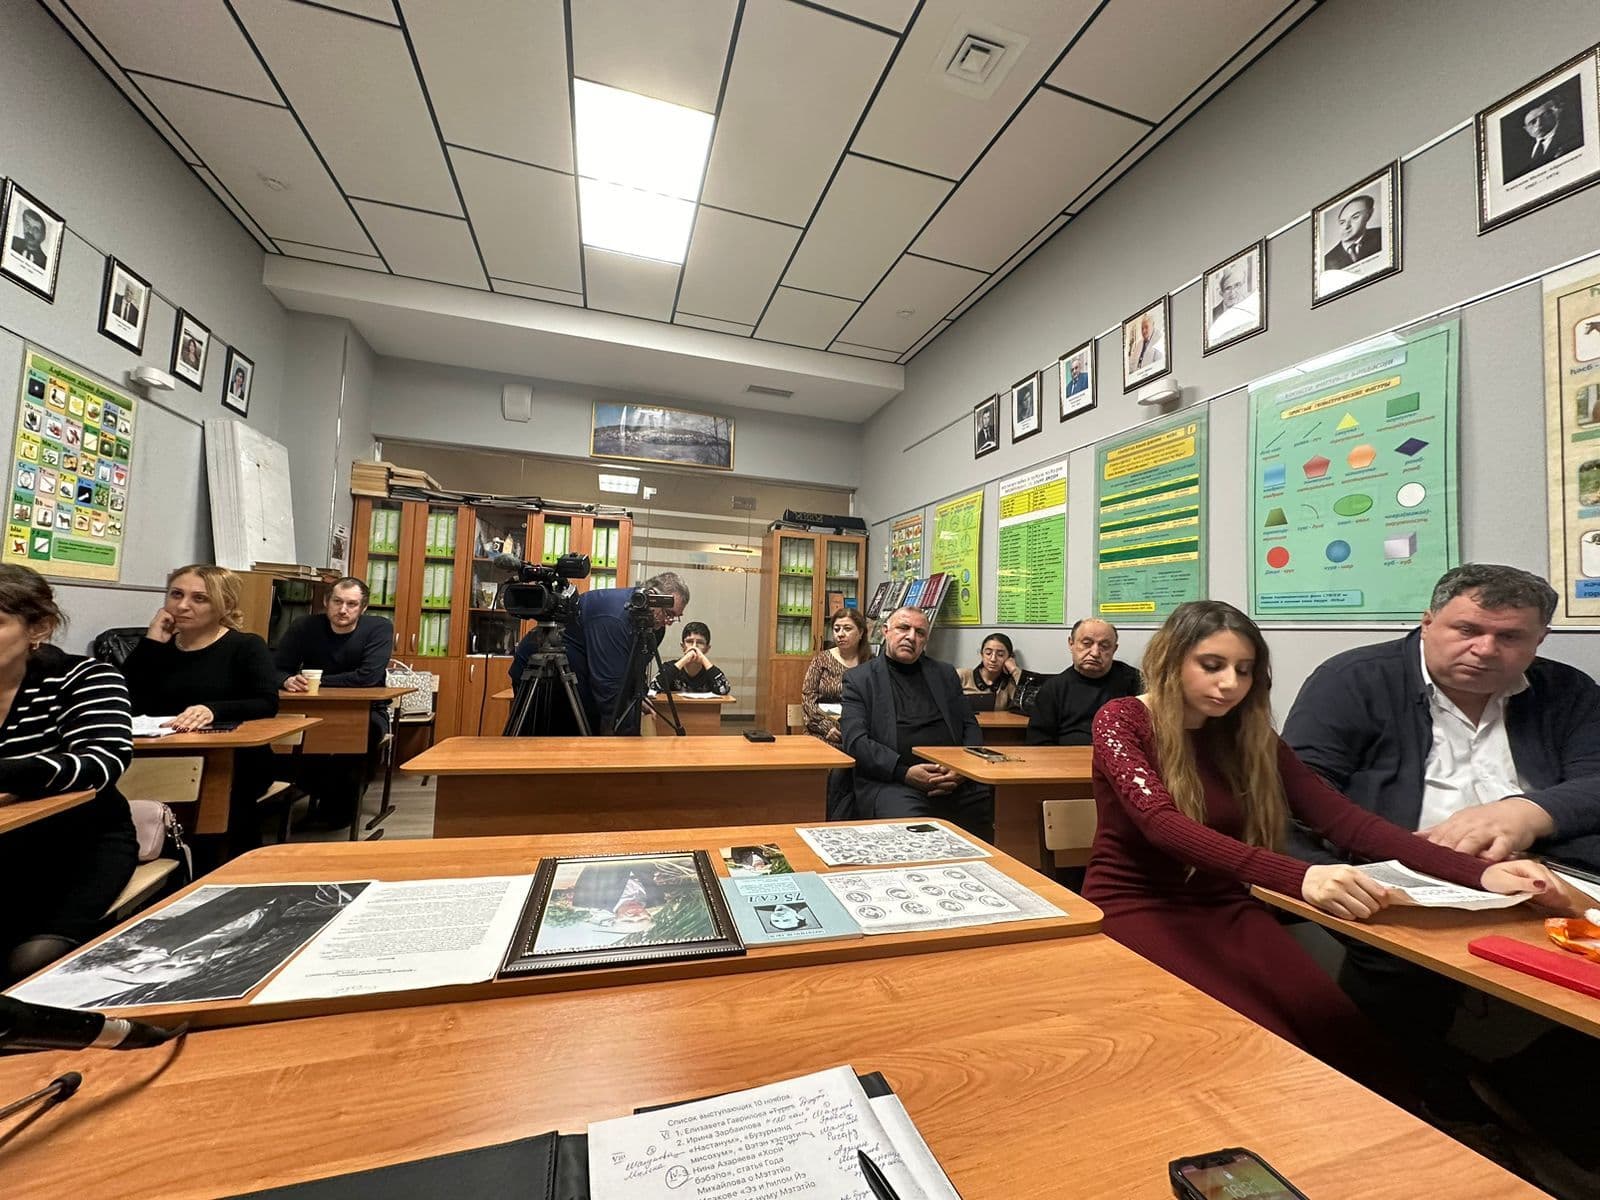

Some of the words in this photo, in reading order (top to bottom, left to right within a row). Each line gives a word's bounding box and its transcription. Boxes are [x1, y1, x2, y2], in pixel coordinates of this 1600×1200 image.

[784, 892, 804, 902] 75
[668, 1114, 698, 1126] Список
[698, 1103, 752, 1121] выступающих
[753, 1100, 762, 1109] 10
[675, 1130, 682, 1138] 1.
[684, 1118, 726, 1134] Елизавета
[726, 1110, 768, 1126] Гаврилова
[676, 1139, 684, 1147] 2.
[686, 1133, 713, 1145] Ирина
[692, 1164, 715, 1175] Нина
[718, 1153, 756, 1167] Азаряева
[736, 1162, 762, 1174] статья
[696, 1178, 747, 1196] Михайлова
